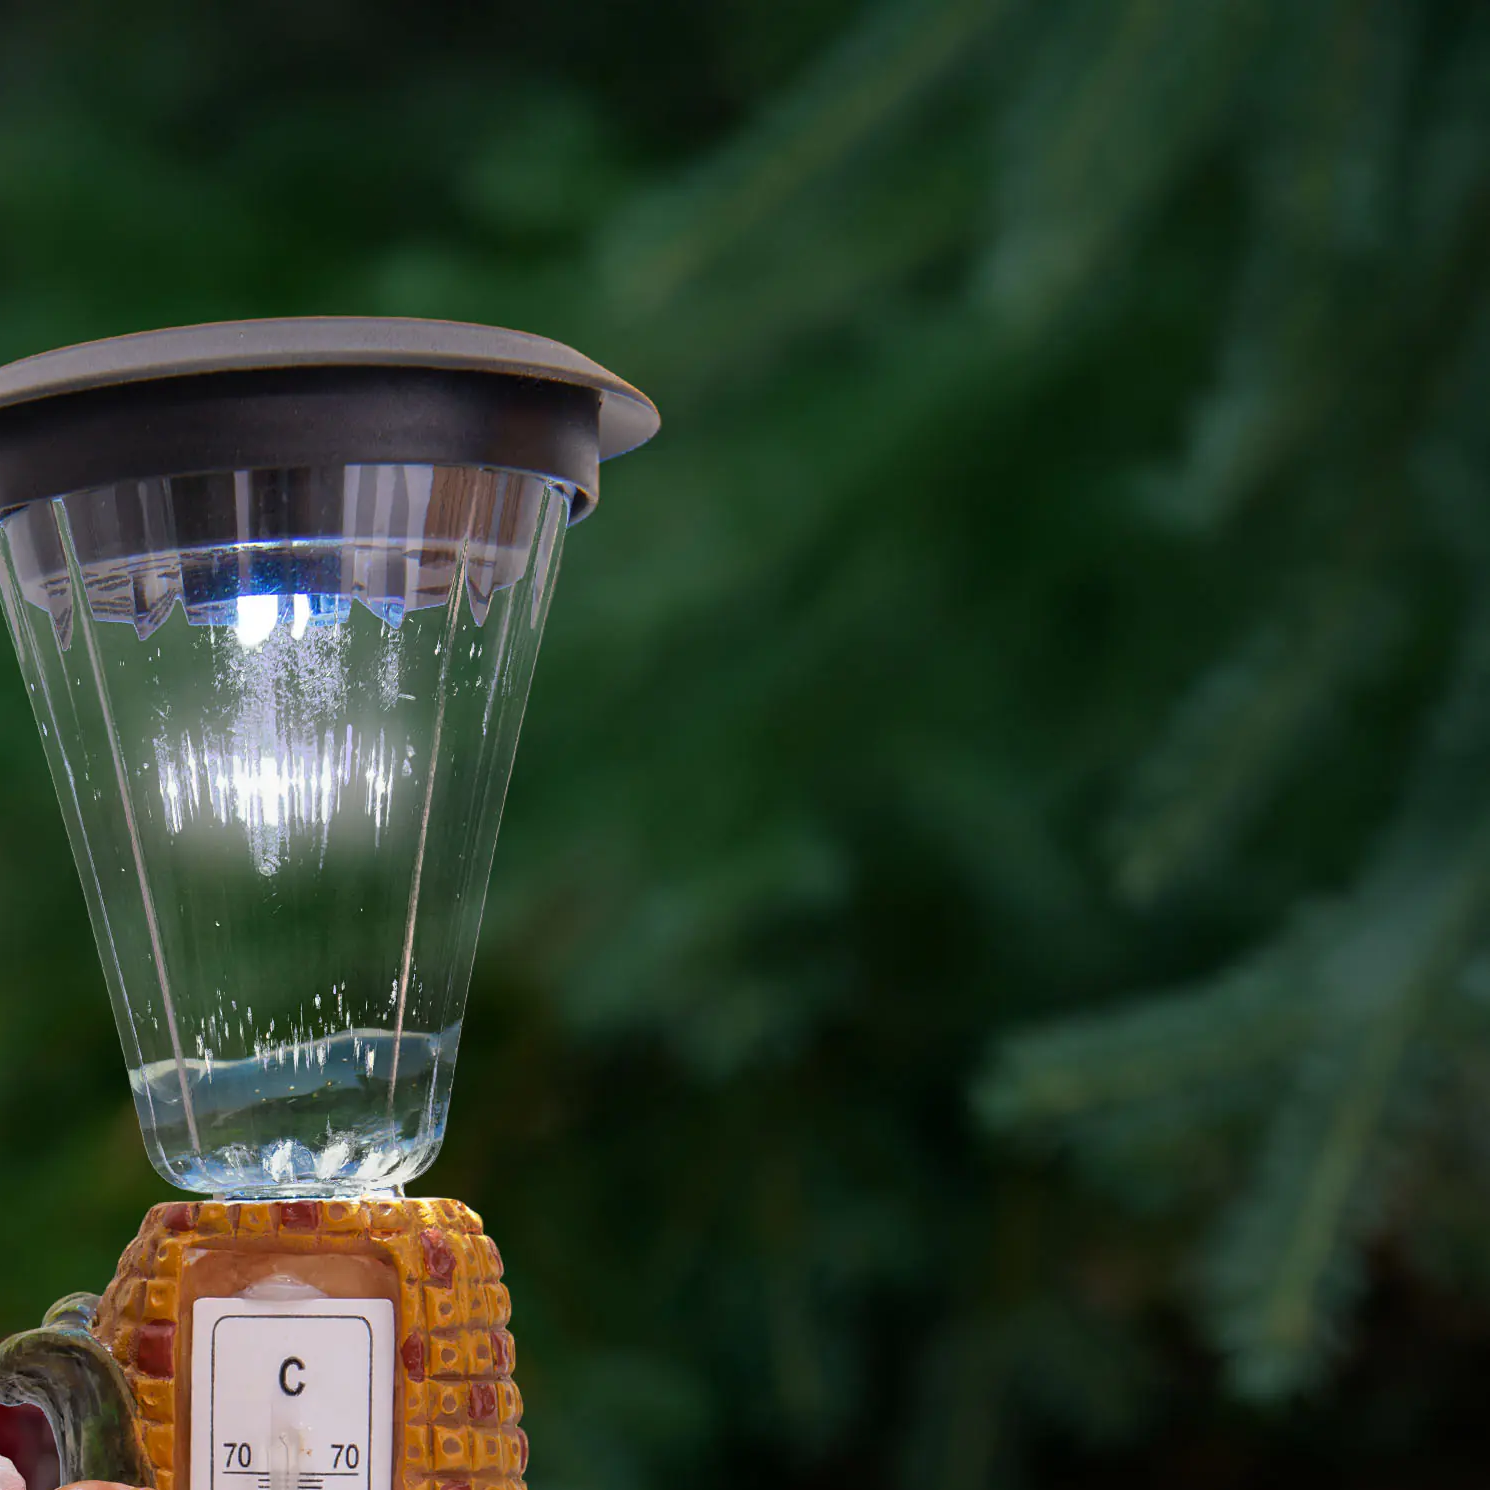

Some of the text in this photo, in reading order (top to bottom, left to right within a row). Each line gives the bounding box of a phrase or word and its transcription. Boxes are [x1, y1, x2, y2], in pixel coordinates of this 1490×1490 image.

[278, 1356, 306, 1397] C
[223, 1442, 252, 1469] 70
[330, 1443, 360, 1470] 70
